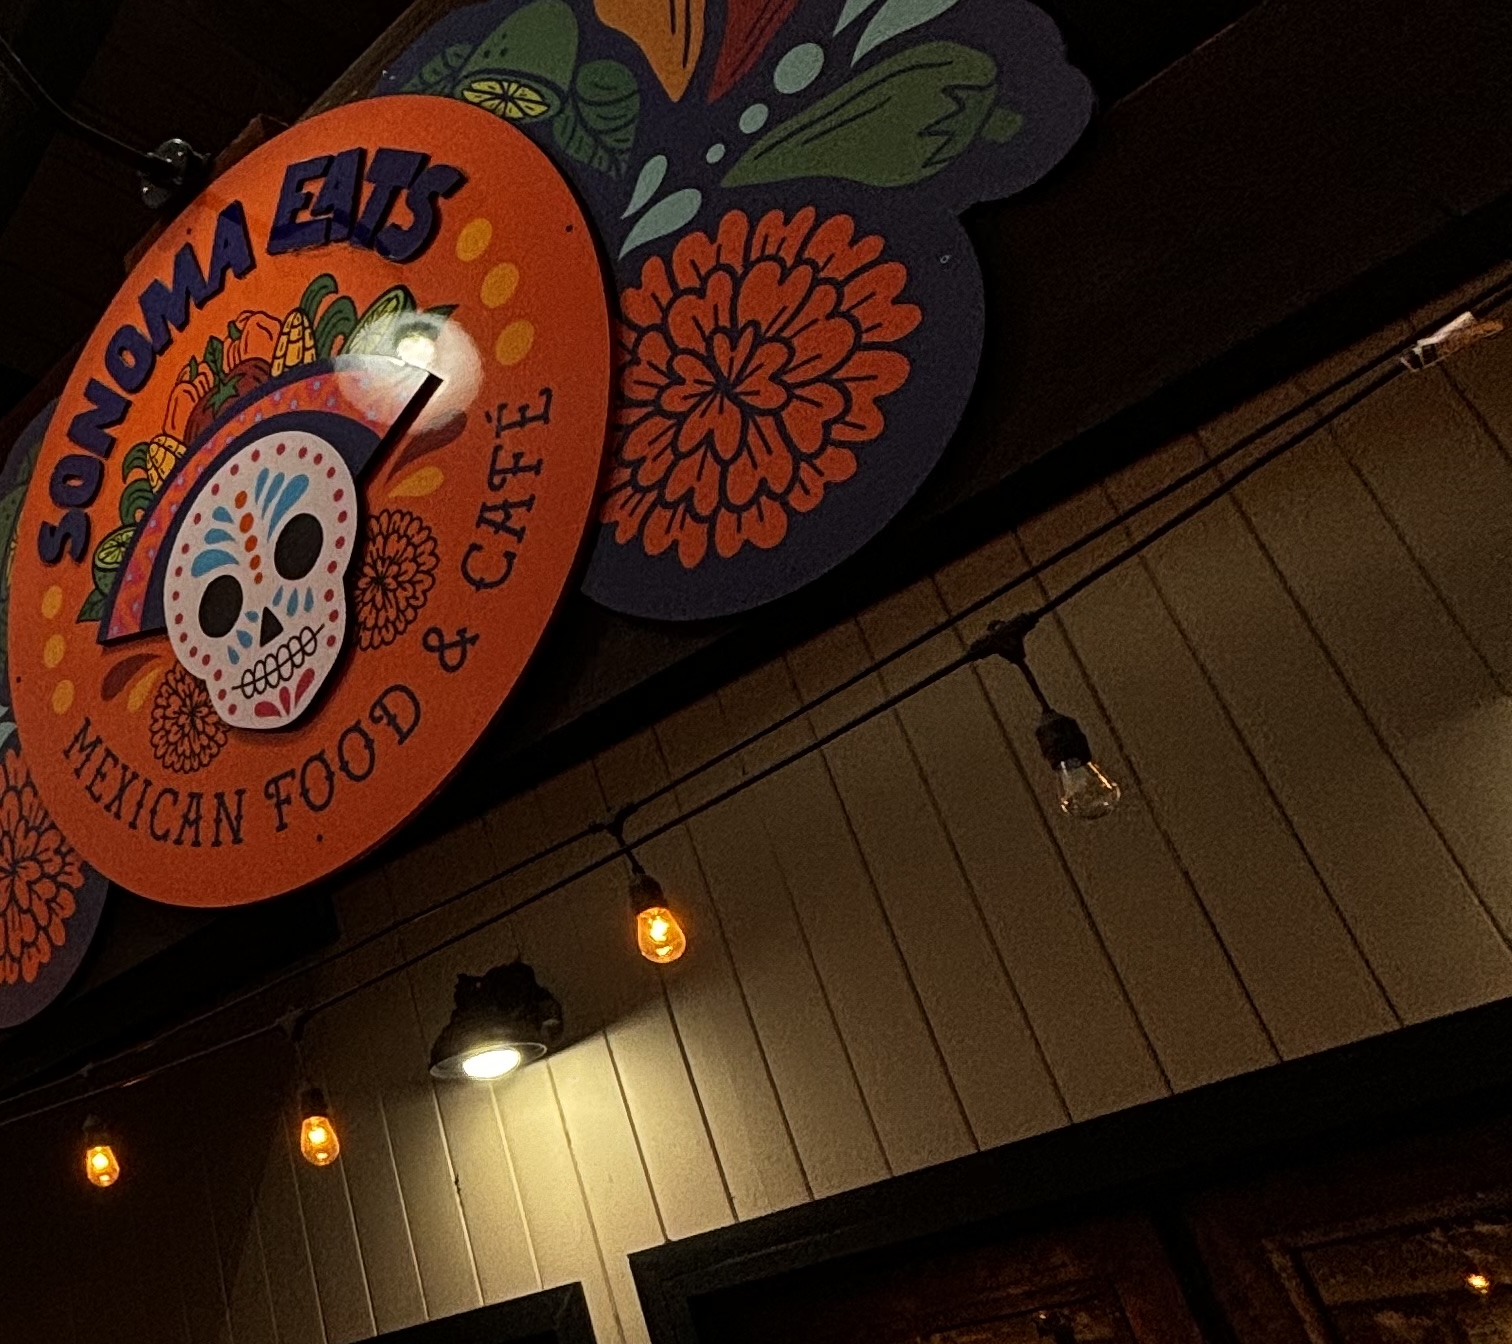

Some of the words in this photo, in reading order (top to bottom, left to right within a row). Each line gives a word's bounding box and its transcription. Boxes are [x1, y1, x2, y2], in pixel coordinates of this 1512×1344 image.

[37, 199, 257, 564] SONOMA
[267, 147, 468, 264] EATS
[63, 717, 247, 848] MEXICAN
[264, 684, 421, 833] FOOD
[422, 626, 479, 673] &
